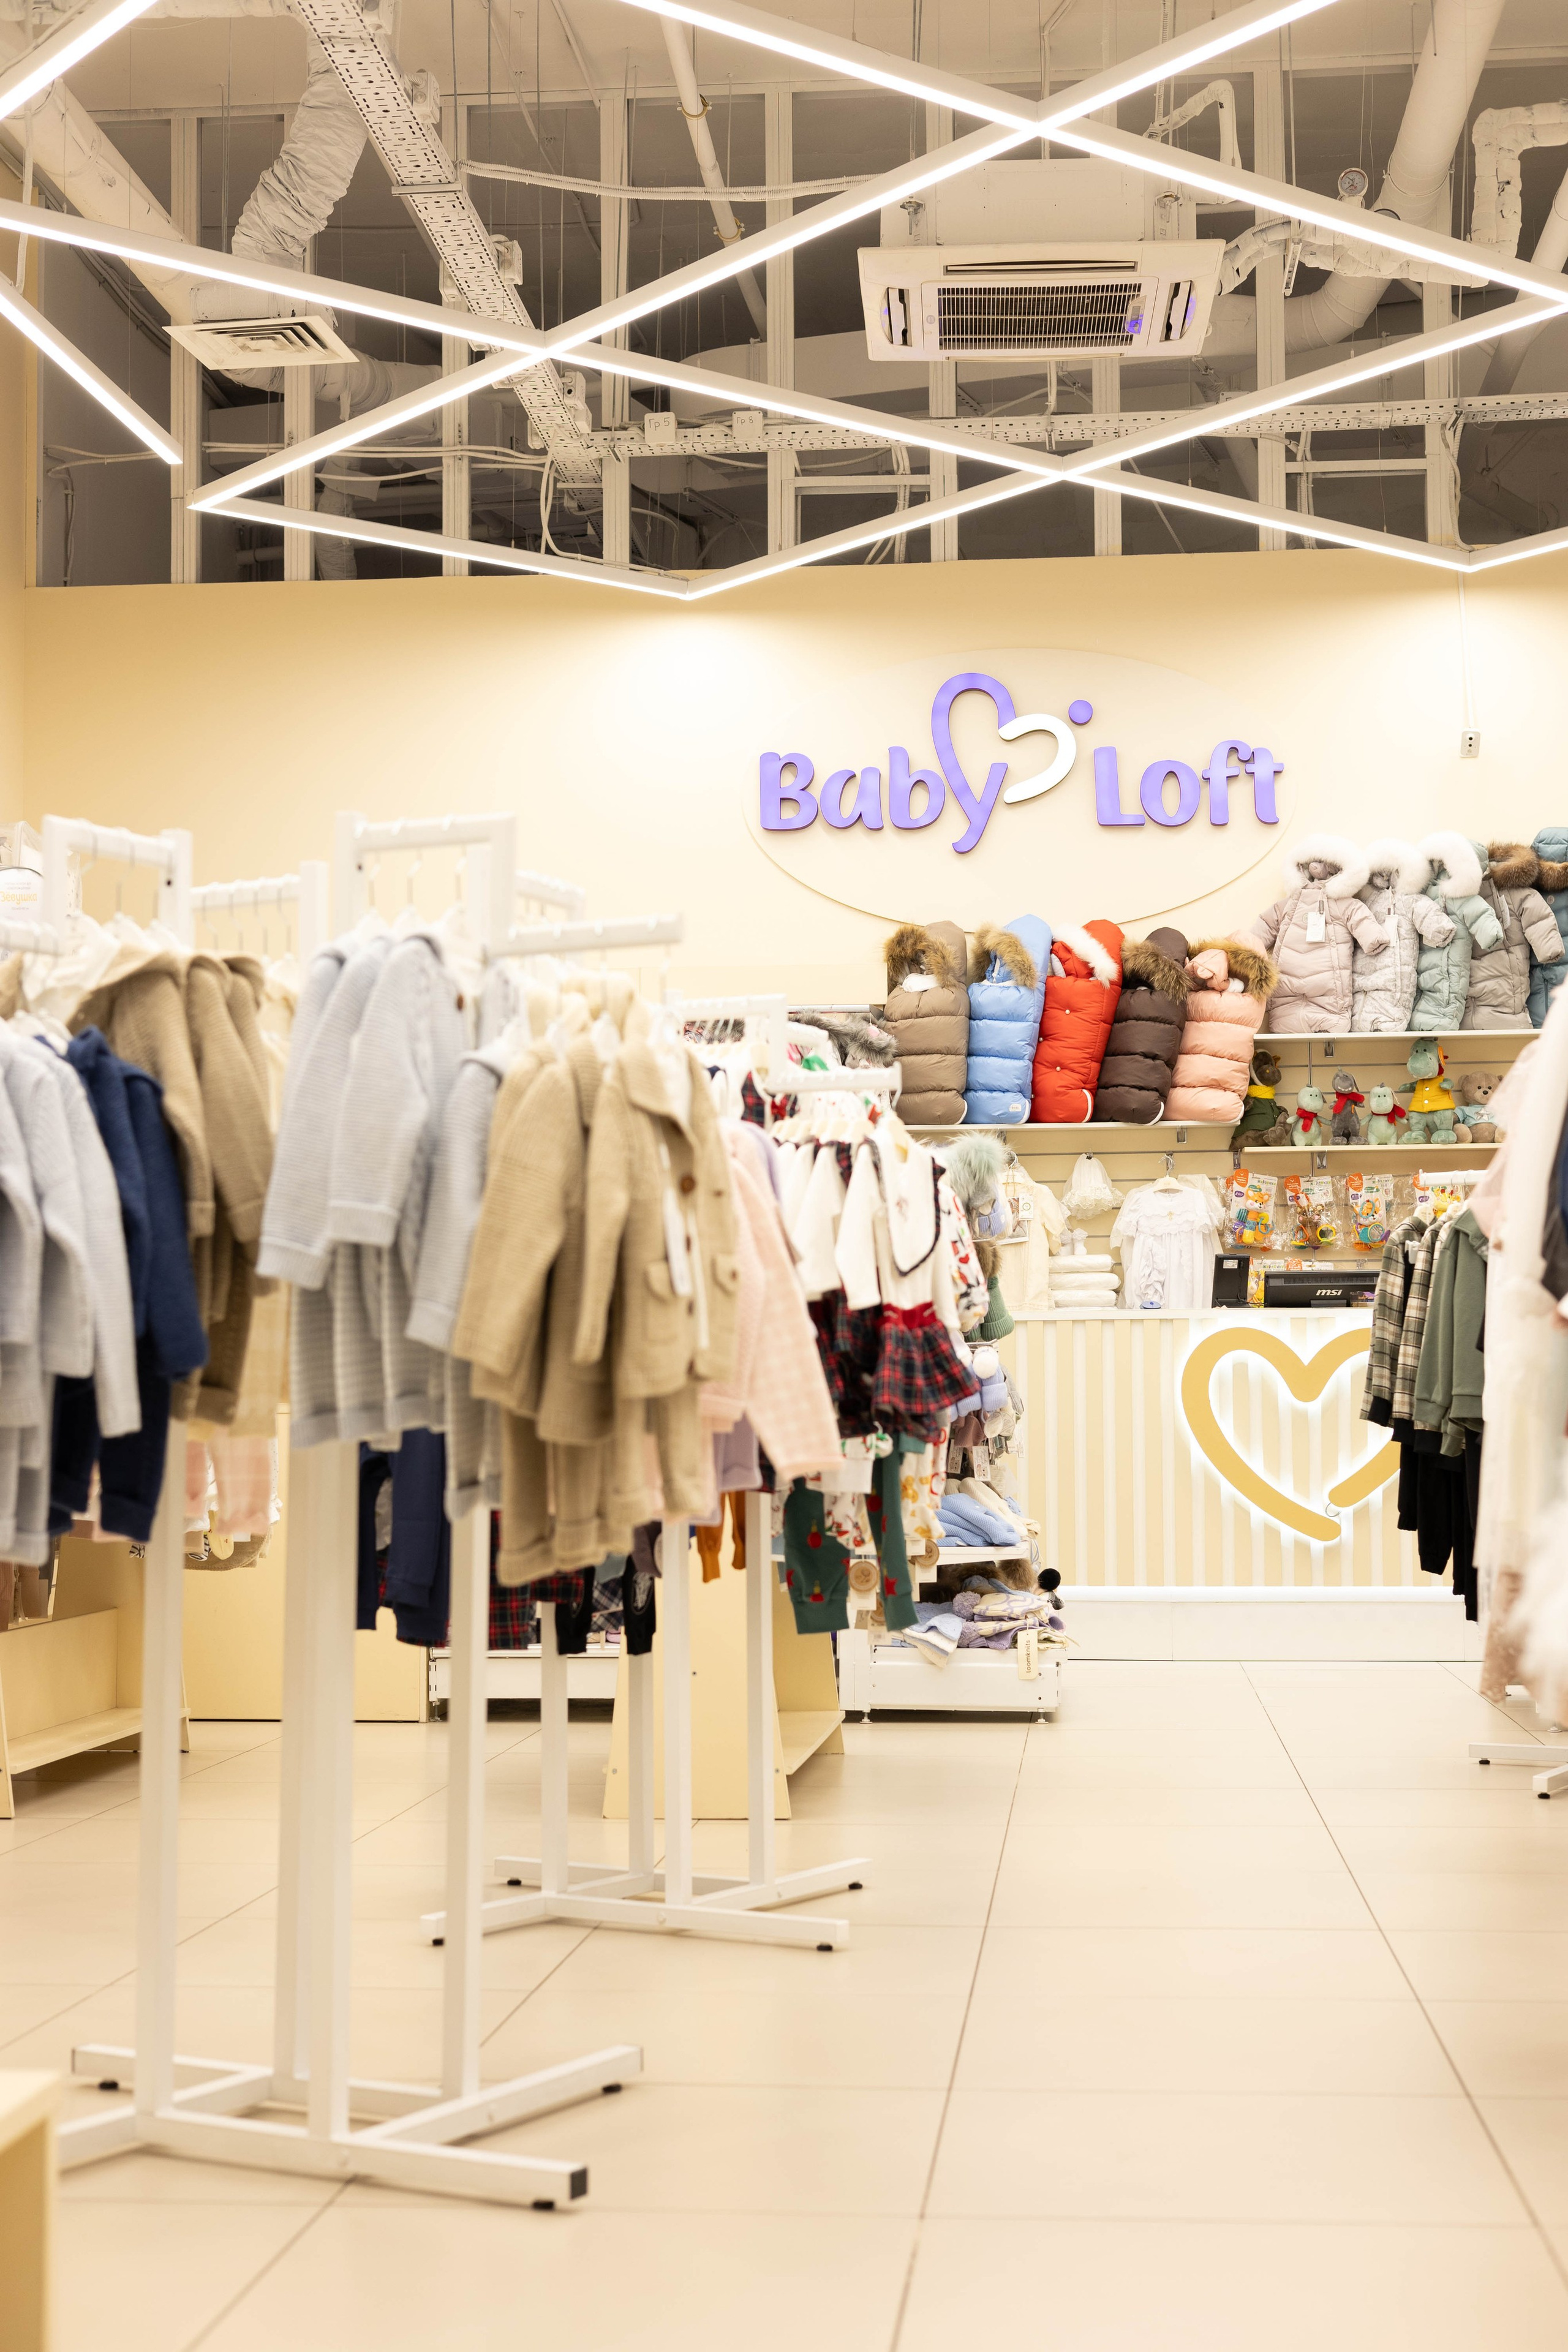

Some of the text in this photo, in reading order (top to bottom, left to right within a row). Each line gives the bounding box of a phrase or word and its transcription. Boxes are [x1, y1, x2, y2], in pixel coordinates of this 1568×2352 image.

[649, 417, 670, 431] Гр 5
[760, 673, 1284, 854] Baby Loft
